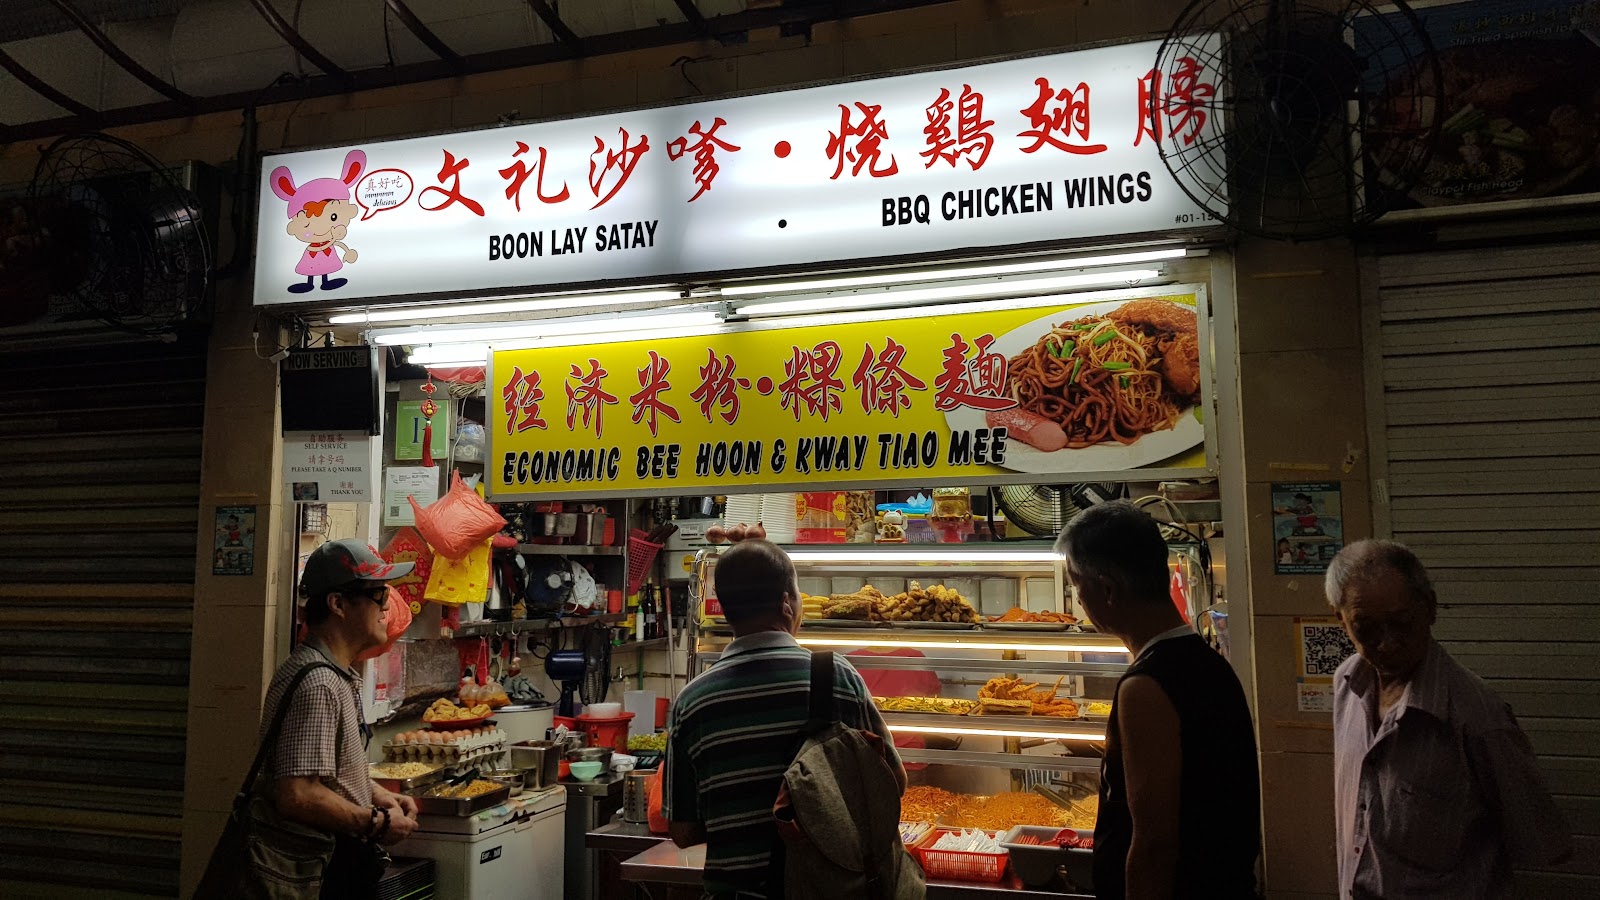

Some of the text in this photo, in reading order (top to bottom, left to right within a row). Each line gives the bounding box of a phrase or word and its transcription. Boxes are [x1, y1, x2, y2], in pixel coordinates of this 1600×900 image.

[365, 176, 403, 191] 真好吃
[1467, 181, 1489, 191] Fish
[882, 171, 1153, 226] BBQ CHICKEN WINGS
[489, 220, 658, 261] BOON LAY SATAY
[288, 353, 310, 369] NOW
[313, 351, 357, 368] SERVING
[310, 434, 344, 443] 自助服务
[503, 426, 1009, 486] ECONOMIC BEE HOON & KWAY TIAO MEE
